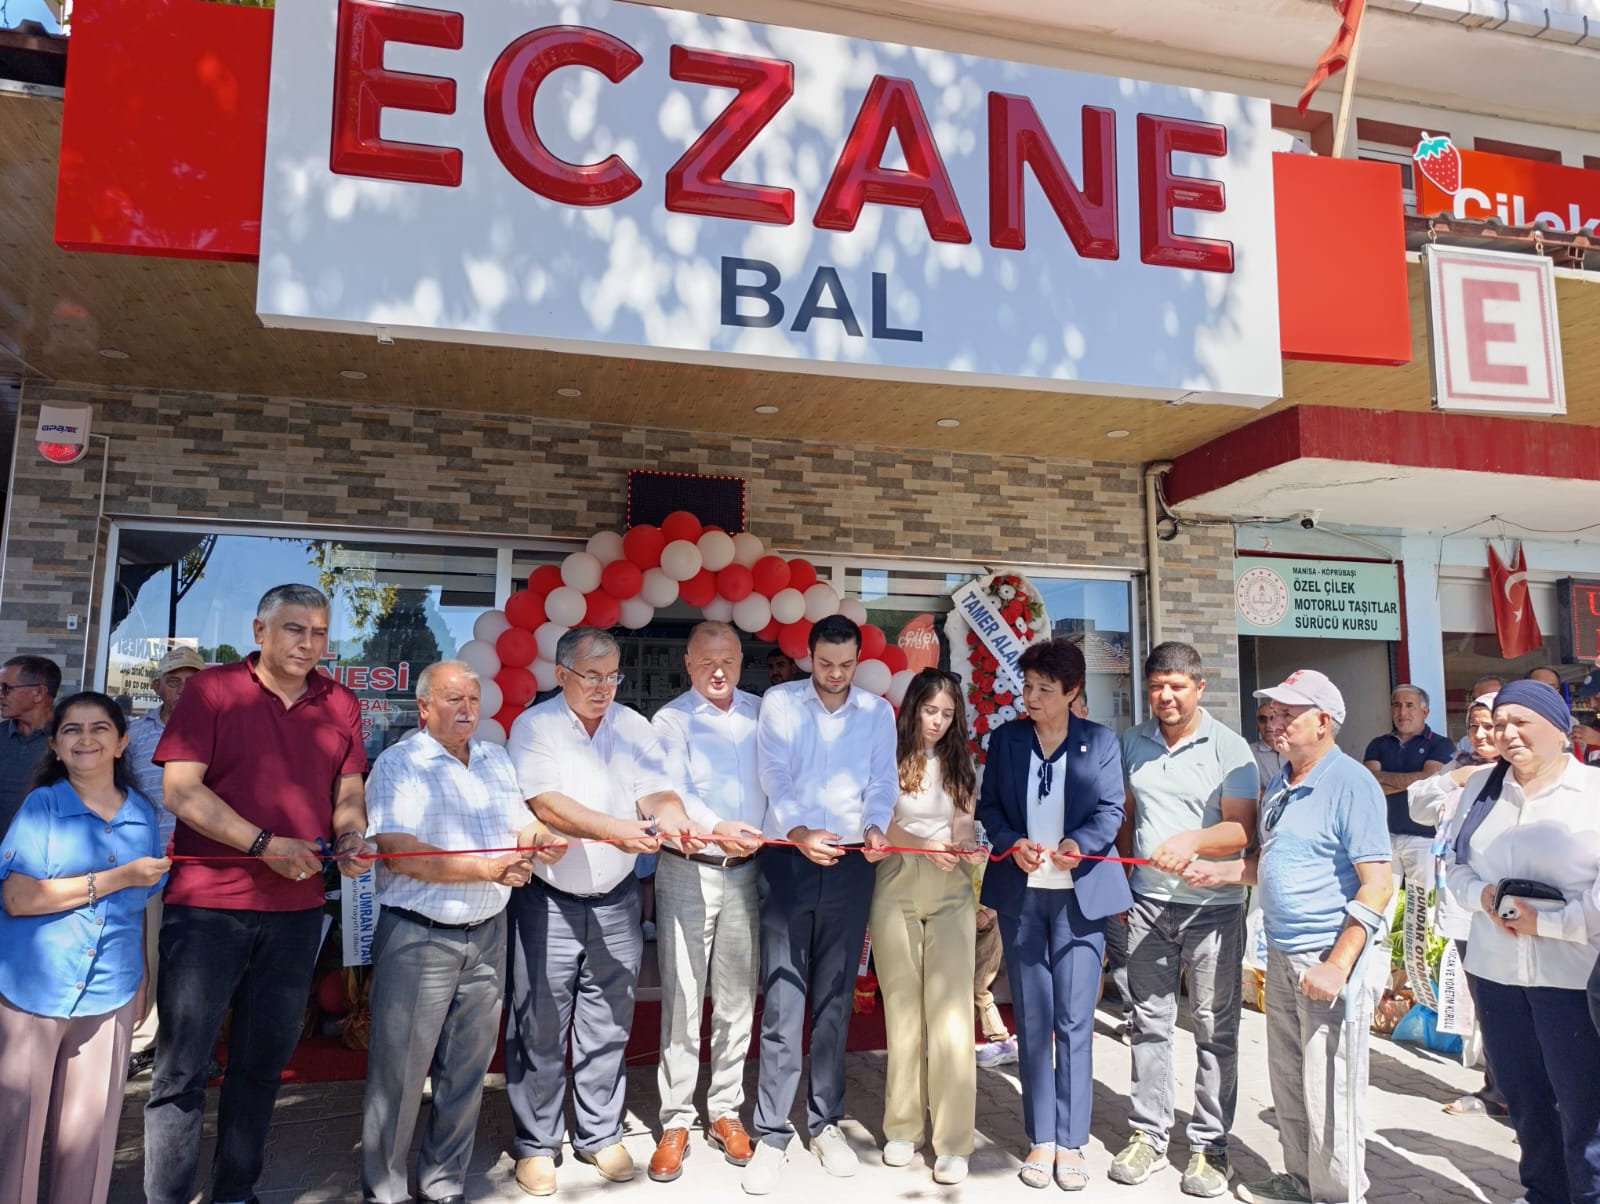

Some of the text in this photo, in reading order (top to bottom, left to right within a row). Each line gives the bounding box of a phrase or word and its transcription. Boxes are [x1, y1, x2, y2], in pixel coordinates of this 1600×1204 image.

[329, 0, 1235, 273] ECZANE
[721, 256, 923, 342] BAL
[1462, 278, 1528, 385] E
[1293, 577, 1355, 596] ÖZEL ÇİLEK
[1294, 598, 1397, 615] MOTORLU TAŞITLAR
[961, 590, 1000, 637] TAMER
[1295, 614, 1378, 631] SÜRÜCÜ KURSU
